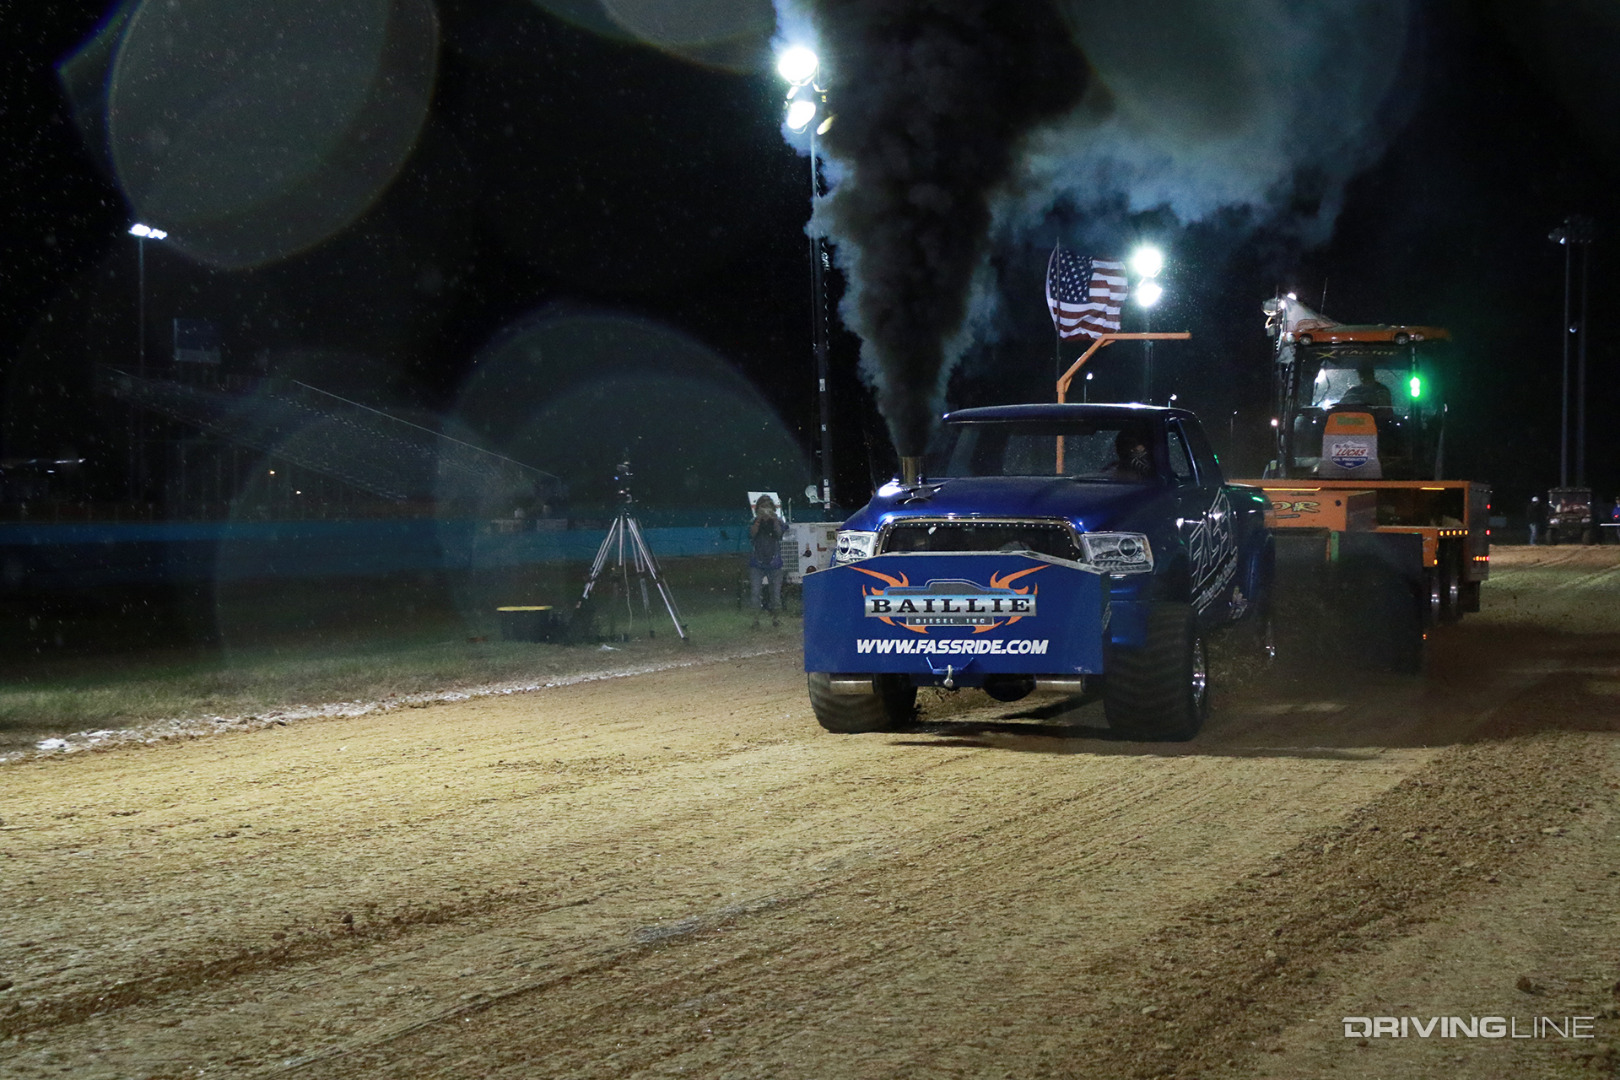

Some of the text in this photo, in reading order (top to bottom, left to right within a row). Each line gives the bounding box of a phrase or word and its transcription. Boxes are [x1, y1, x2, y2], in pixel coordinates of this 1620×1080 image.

[1336, 448, 1367, 457] LUCAS
[871, 598, 1031, 613] BAILLIE
[856, 639, 1049, 655] WWW.FASSRIDE.COM
